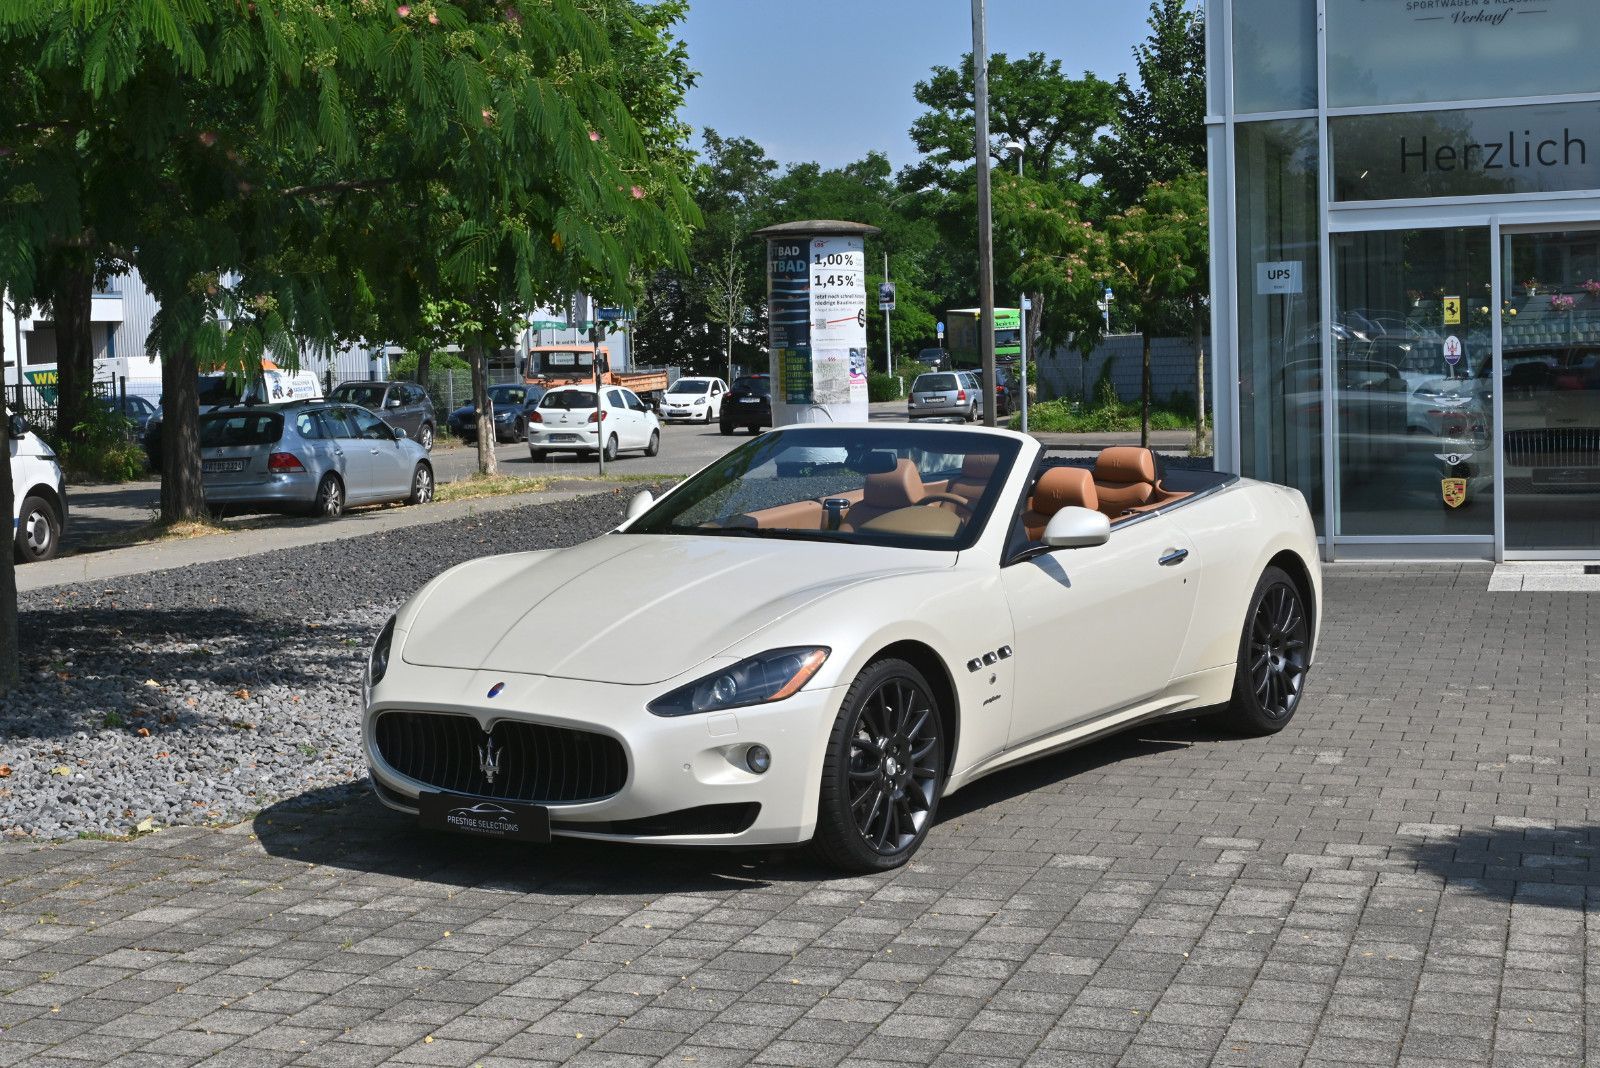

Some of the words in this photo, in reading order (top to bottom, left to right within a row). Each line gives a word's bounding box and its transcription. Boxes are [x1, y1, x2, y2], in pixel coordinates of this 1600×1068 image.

[1406, 0, 1479, 11] SPORTWAGEN
[1451, 8, 1514, 25] Verkauf
[1401, 128, 1586, 173] Herzlich
[814, 253, 853, 267] 1,00%
[1267, 269, 1290, 280] UPS
[447, 815, 477, 827] PRESTIGE
[478, 820, 519, 832] SELECTIONS
